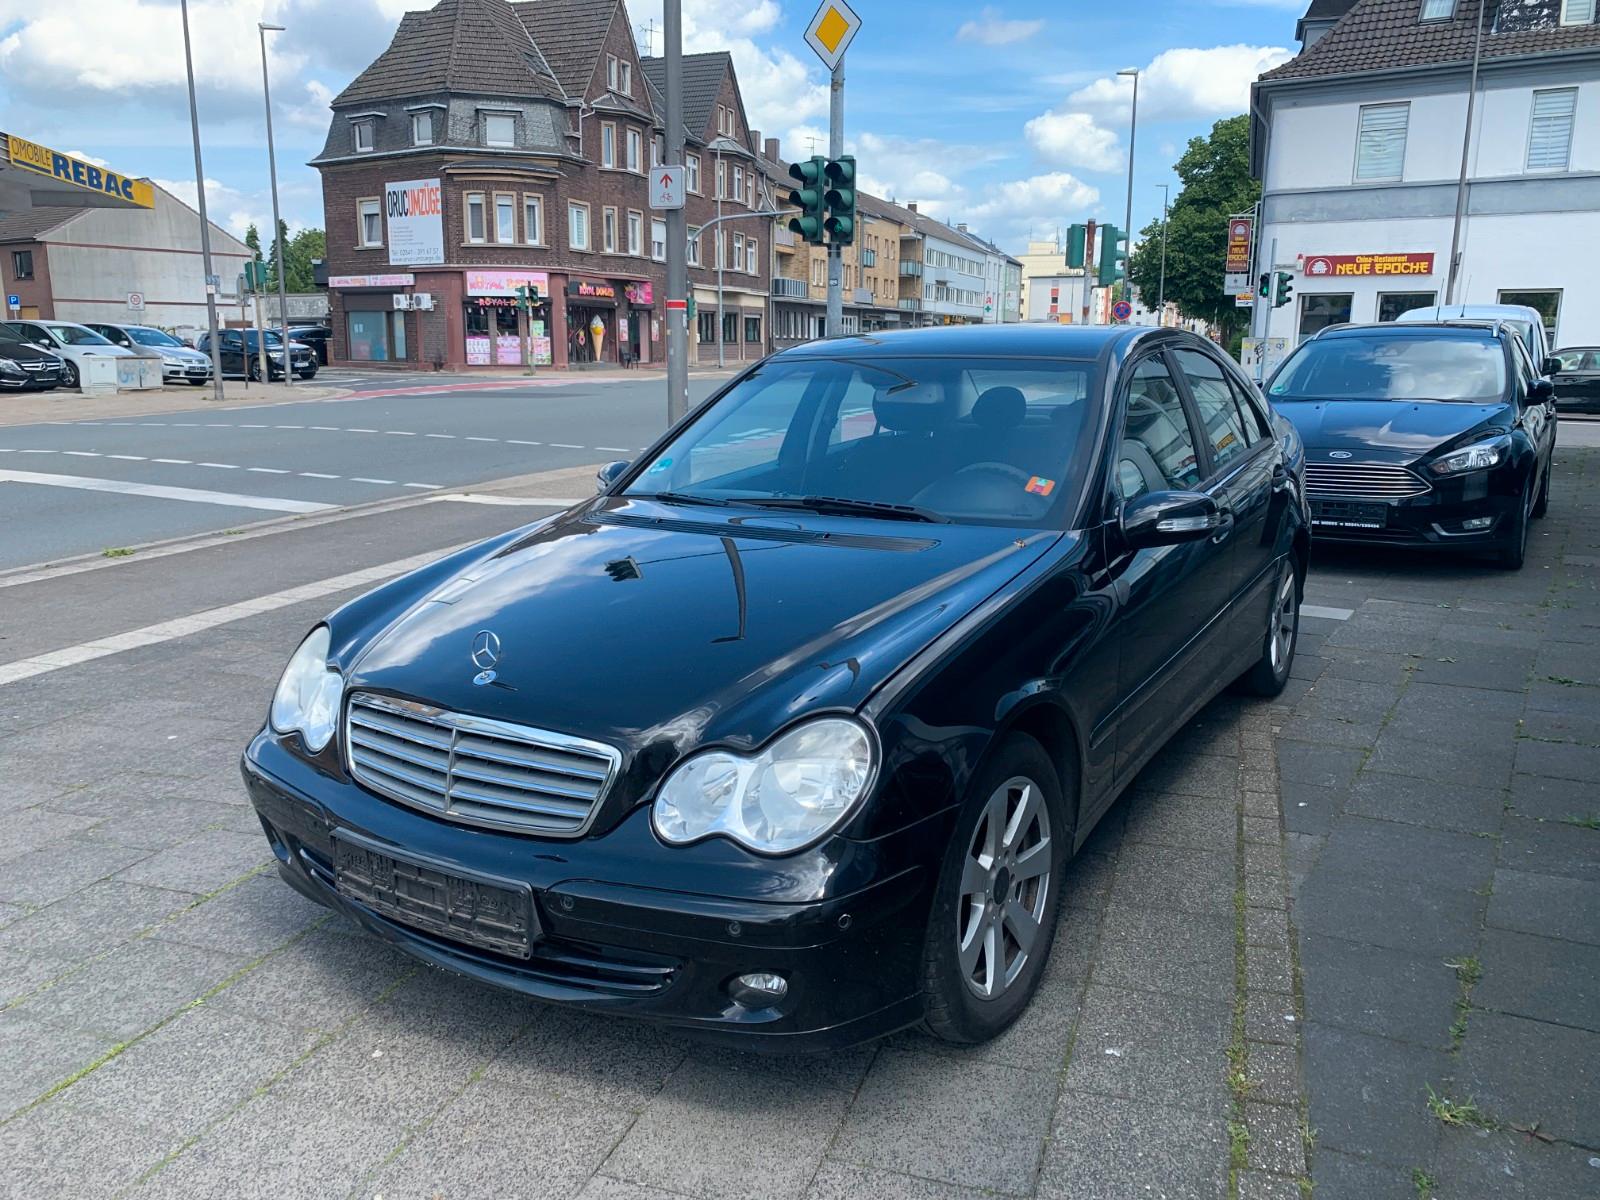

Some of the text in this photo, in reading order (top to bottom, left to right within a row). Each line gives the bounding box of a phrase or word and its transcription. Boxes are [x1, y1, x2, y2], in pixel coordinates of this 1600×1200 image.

[52, 153, 135, 200] REBAC
[1355, 255, 1408, 263] China-Restaurant
[1335, 262, 1429, 275] NEUE EPOCHE
[579, 283, 595, 296] ROYAL
[479, 298, 508, 306] ROYAL
